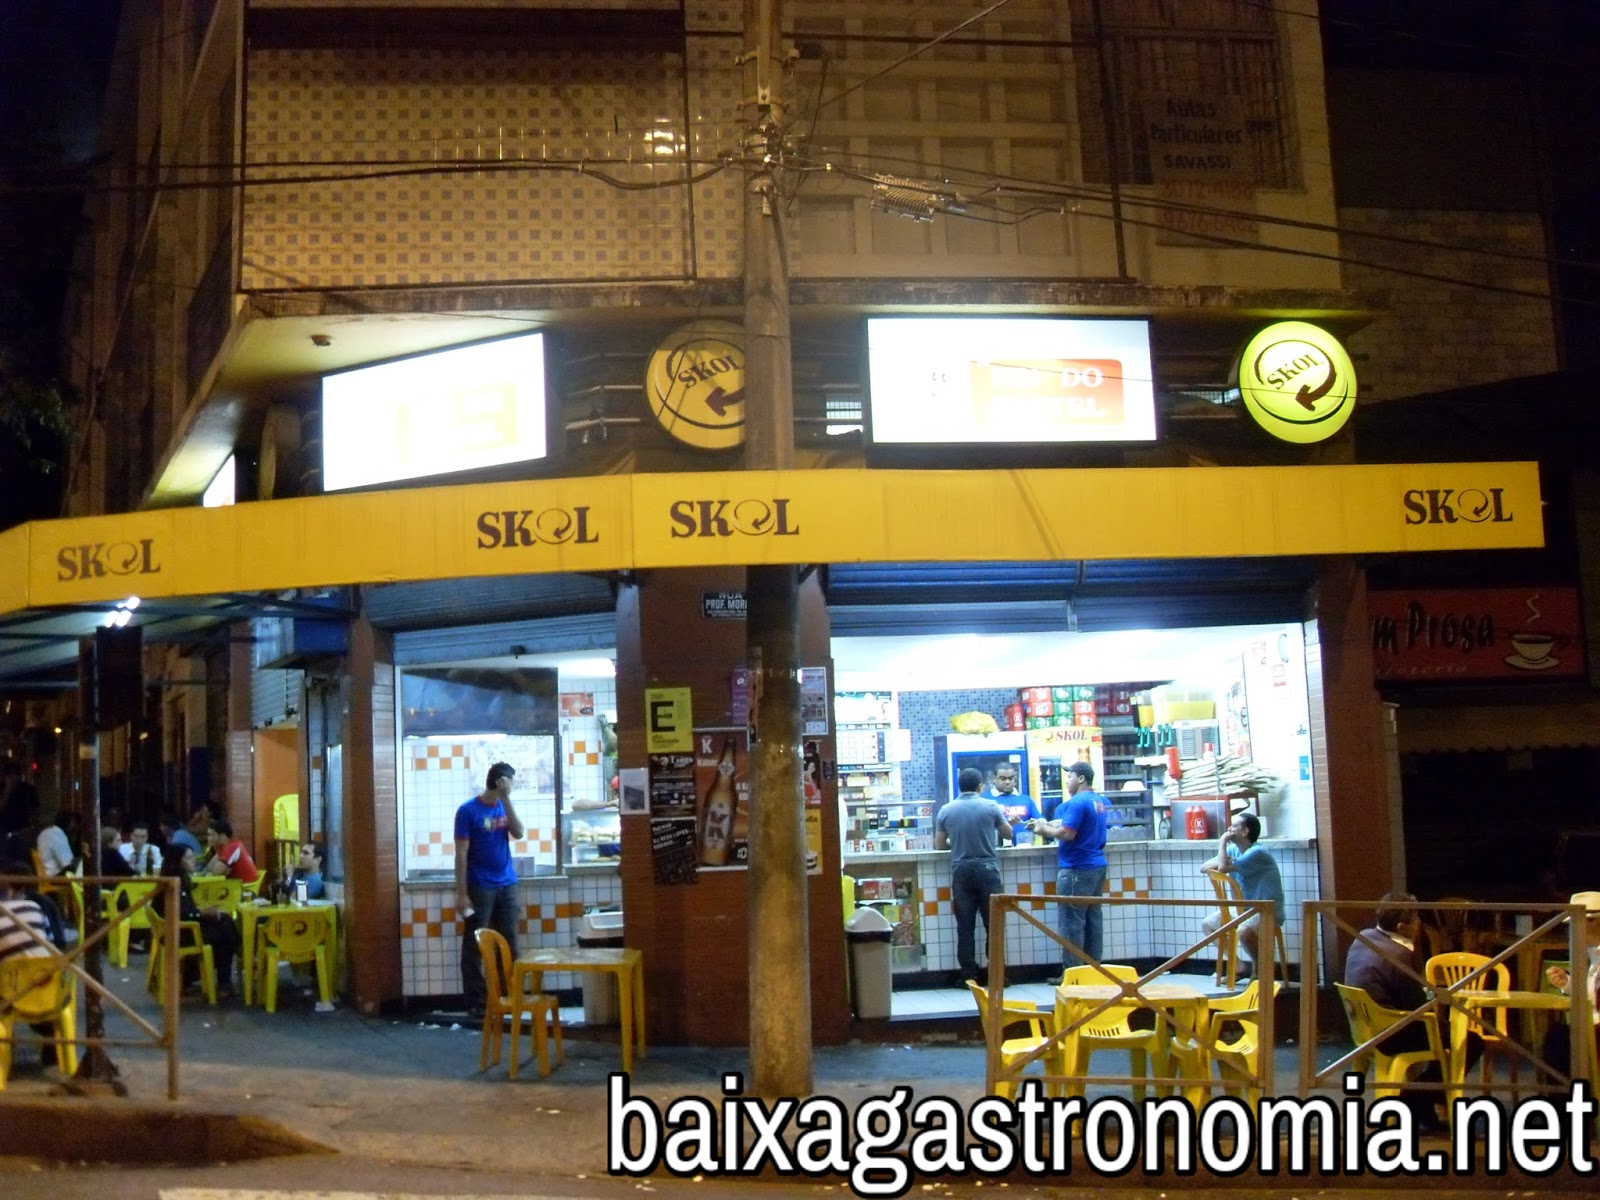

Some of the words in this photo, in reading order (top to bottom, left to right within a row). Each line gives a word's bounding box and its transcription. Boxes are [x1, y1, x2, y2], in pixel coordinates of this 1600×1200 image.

[1060, 367, 1104, 388] DO
[1267, 353, 1325, 391] SKOL
[670, 498, 800, 539] SKOL
[1403, 488, 1514, 525] SKOL
[476, 506, 600, 550] SKOL
[57, 538, 161, 582] SKOL
[705, 599, 726, 610] PROF.
[1056, 730, 1088, 741] SKOL
